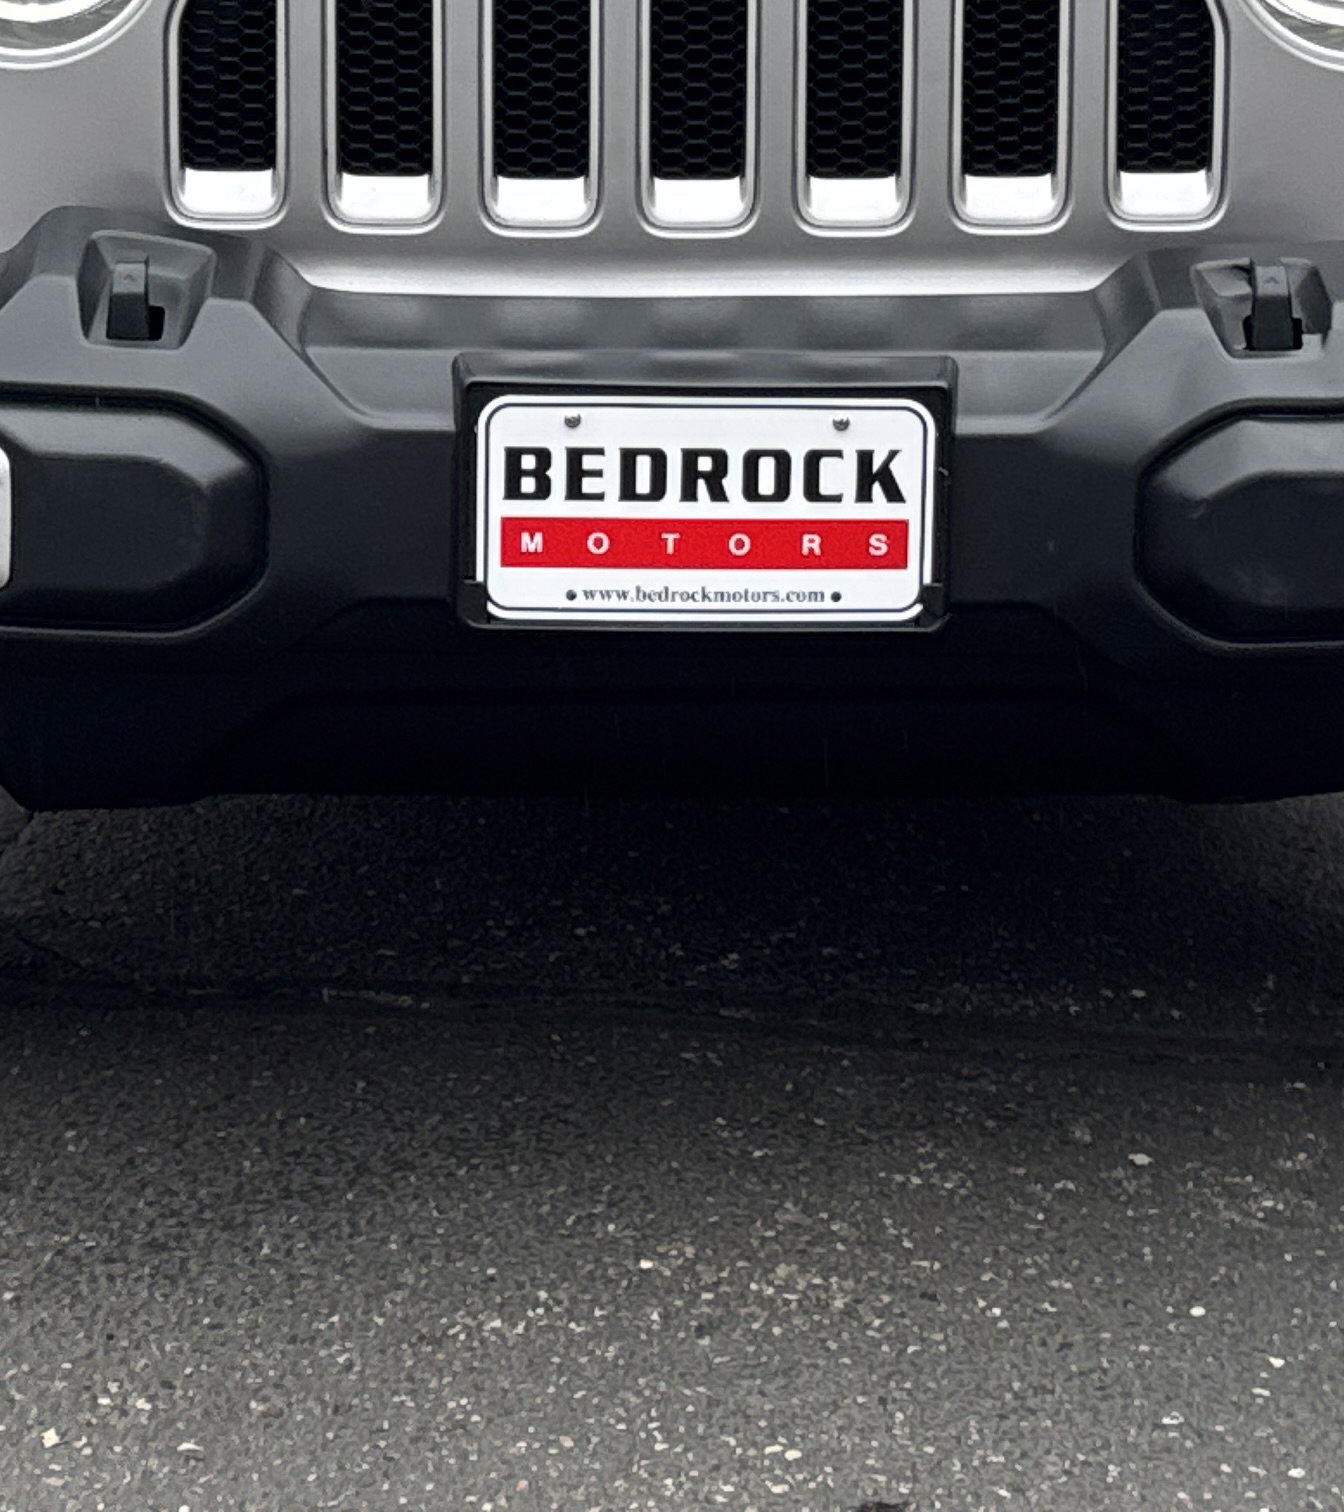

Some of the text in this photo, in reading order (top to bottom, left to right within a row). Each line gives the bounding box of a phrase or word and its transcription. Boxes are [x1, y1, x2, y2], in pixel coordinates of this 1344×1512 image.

[503, 446, 906, 503] BEDROCK
[521, 532, 888, 556] MOTORS
[582, 585, 825, 604] www.bedrockmotors.com
